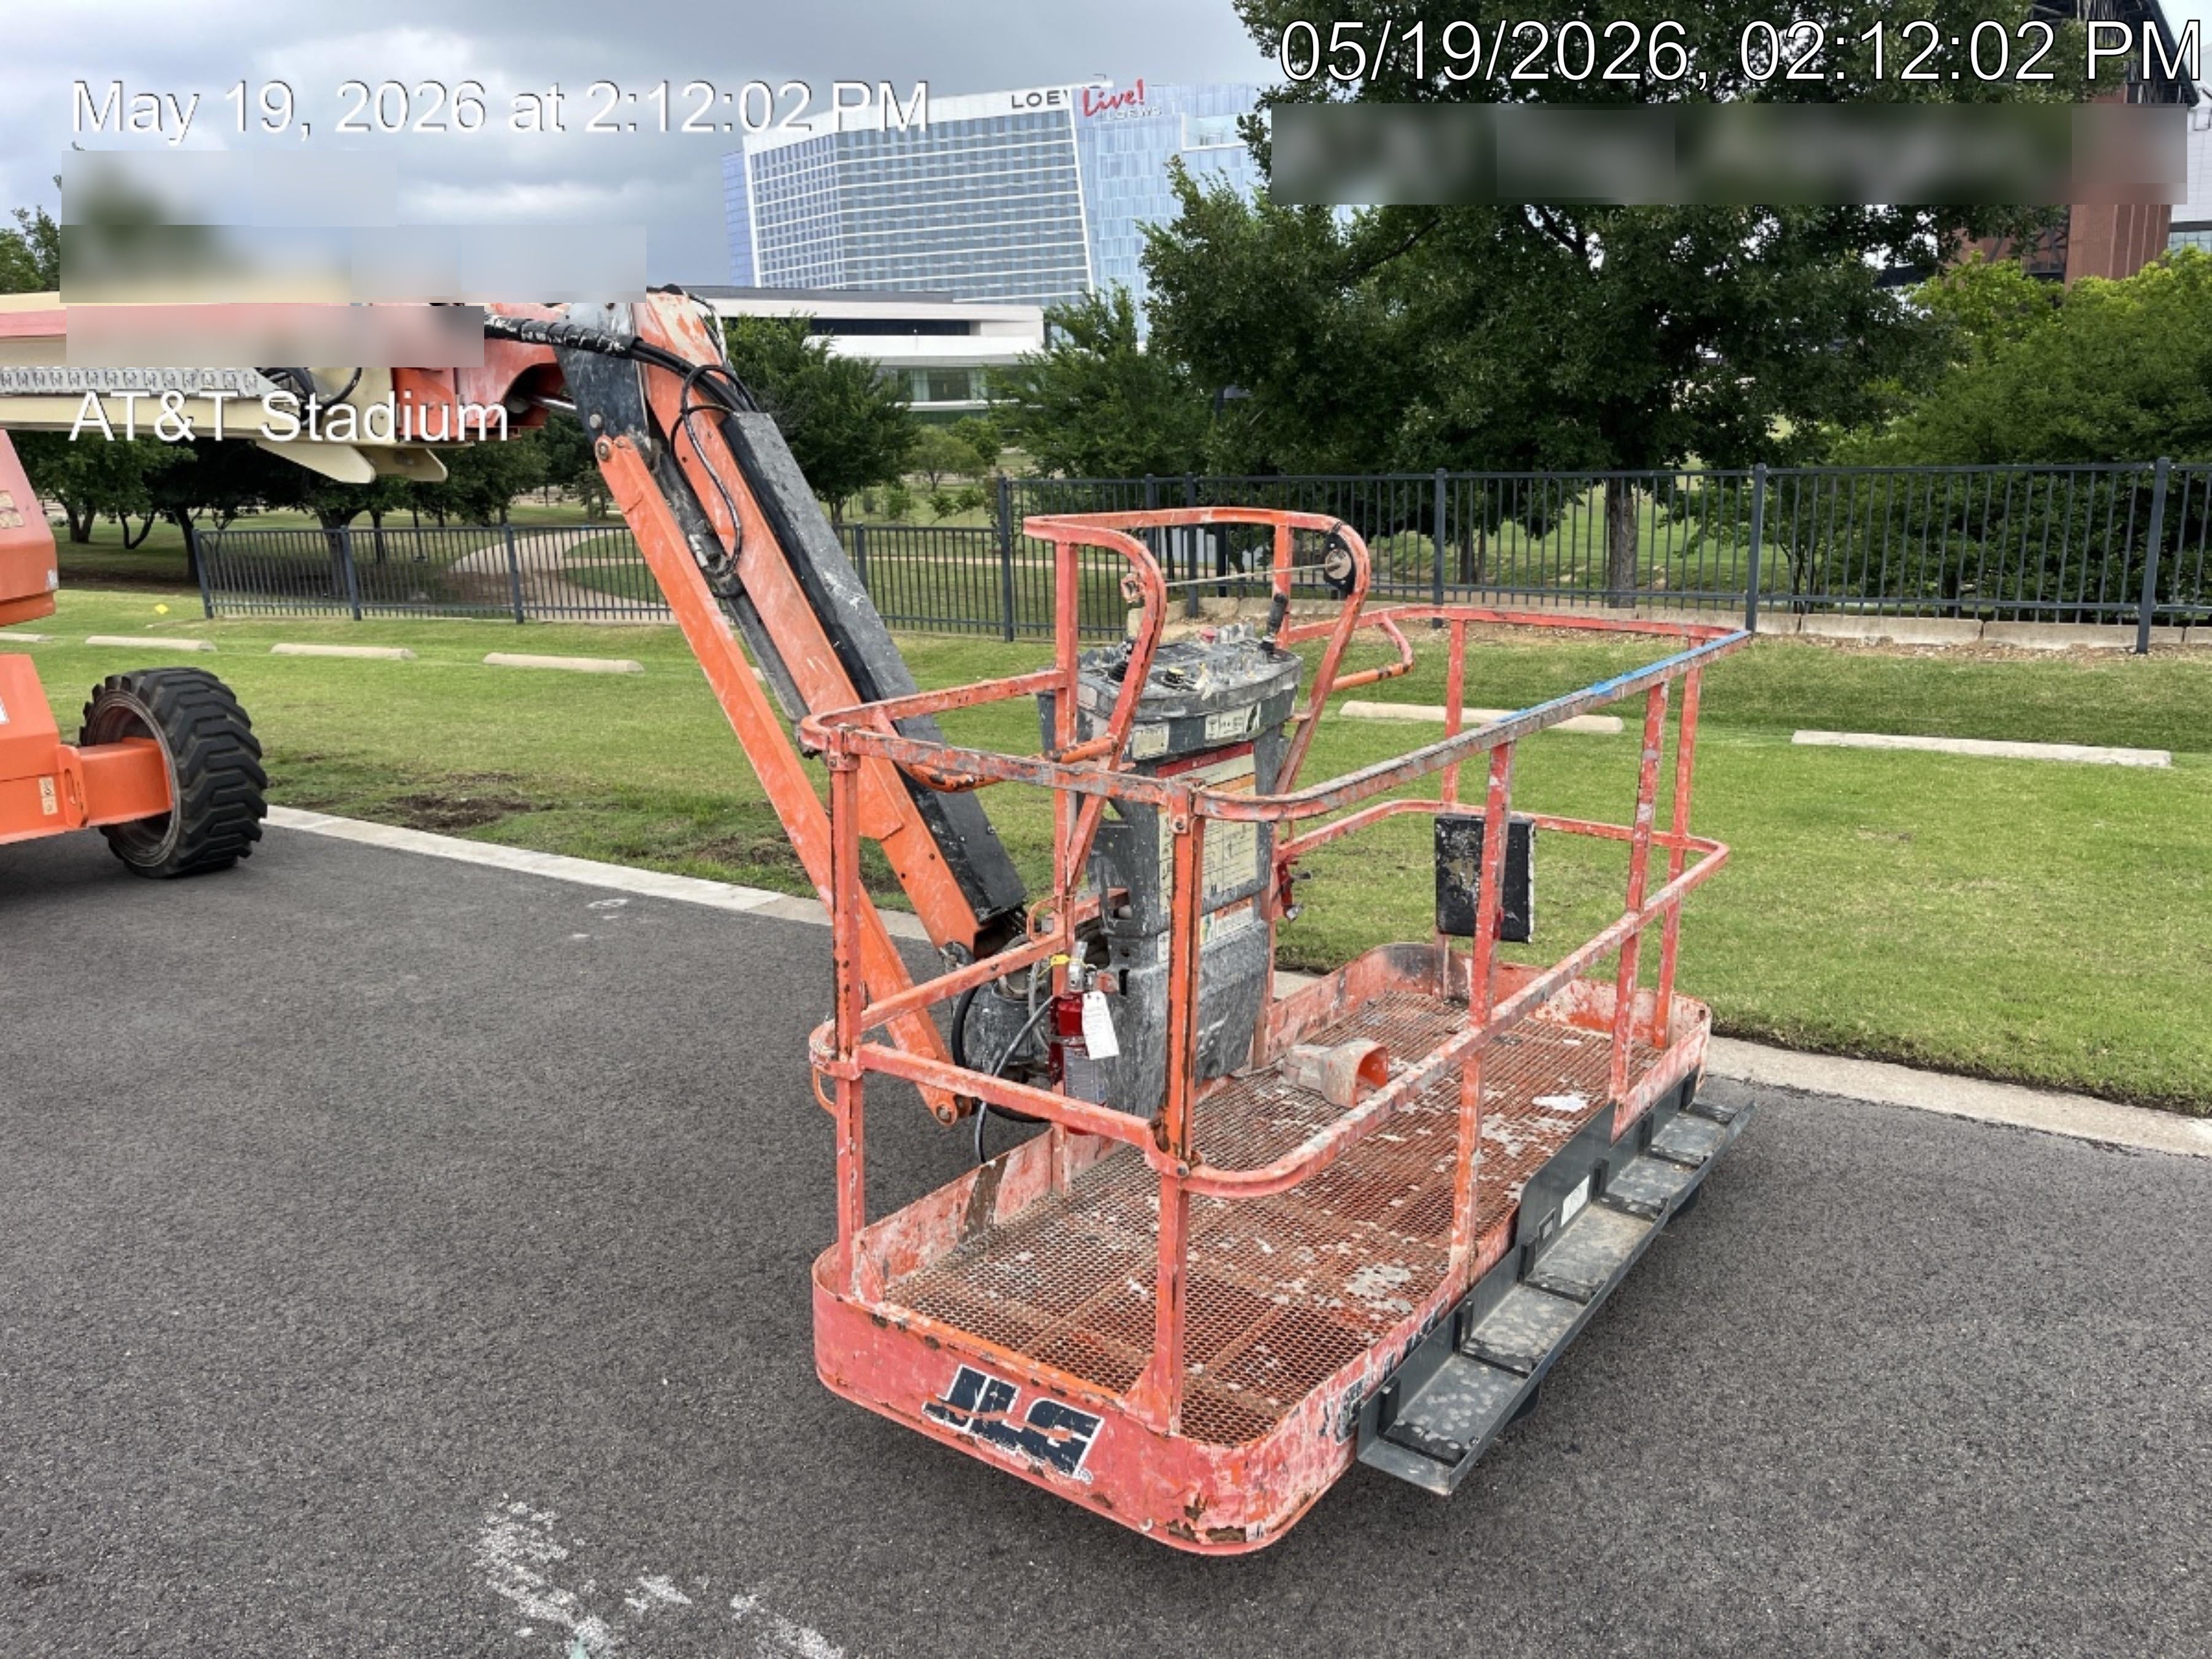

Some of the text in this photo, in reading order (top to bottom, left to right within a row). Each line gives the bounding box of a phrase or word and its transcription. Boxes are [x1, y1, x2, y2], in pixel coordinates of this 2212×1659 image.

[1011, 89, 1068, 109] LOE
[1082, 78, 1145, 117] Live!
[922, 1363, 1105, 1478] JLG
